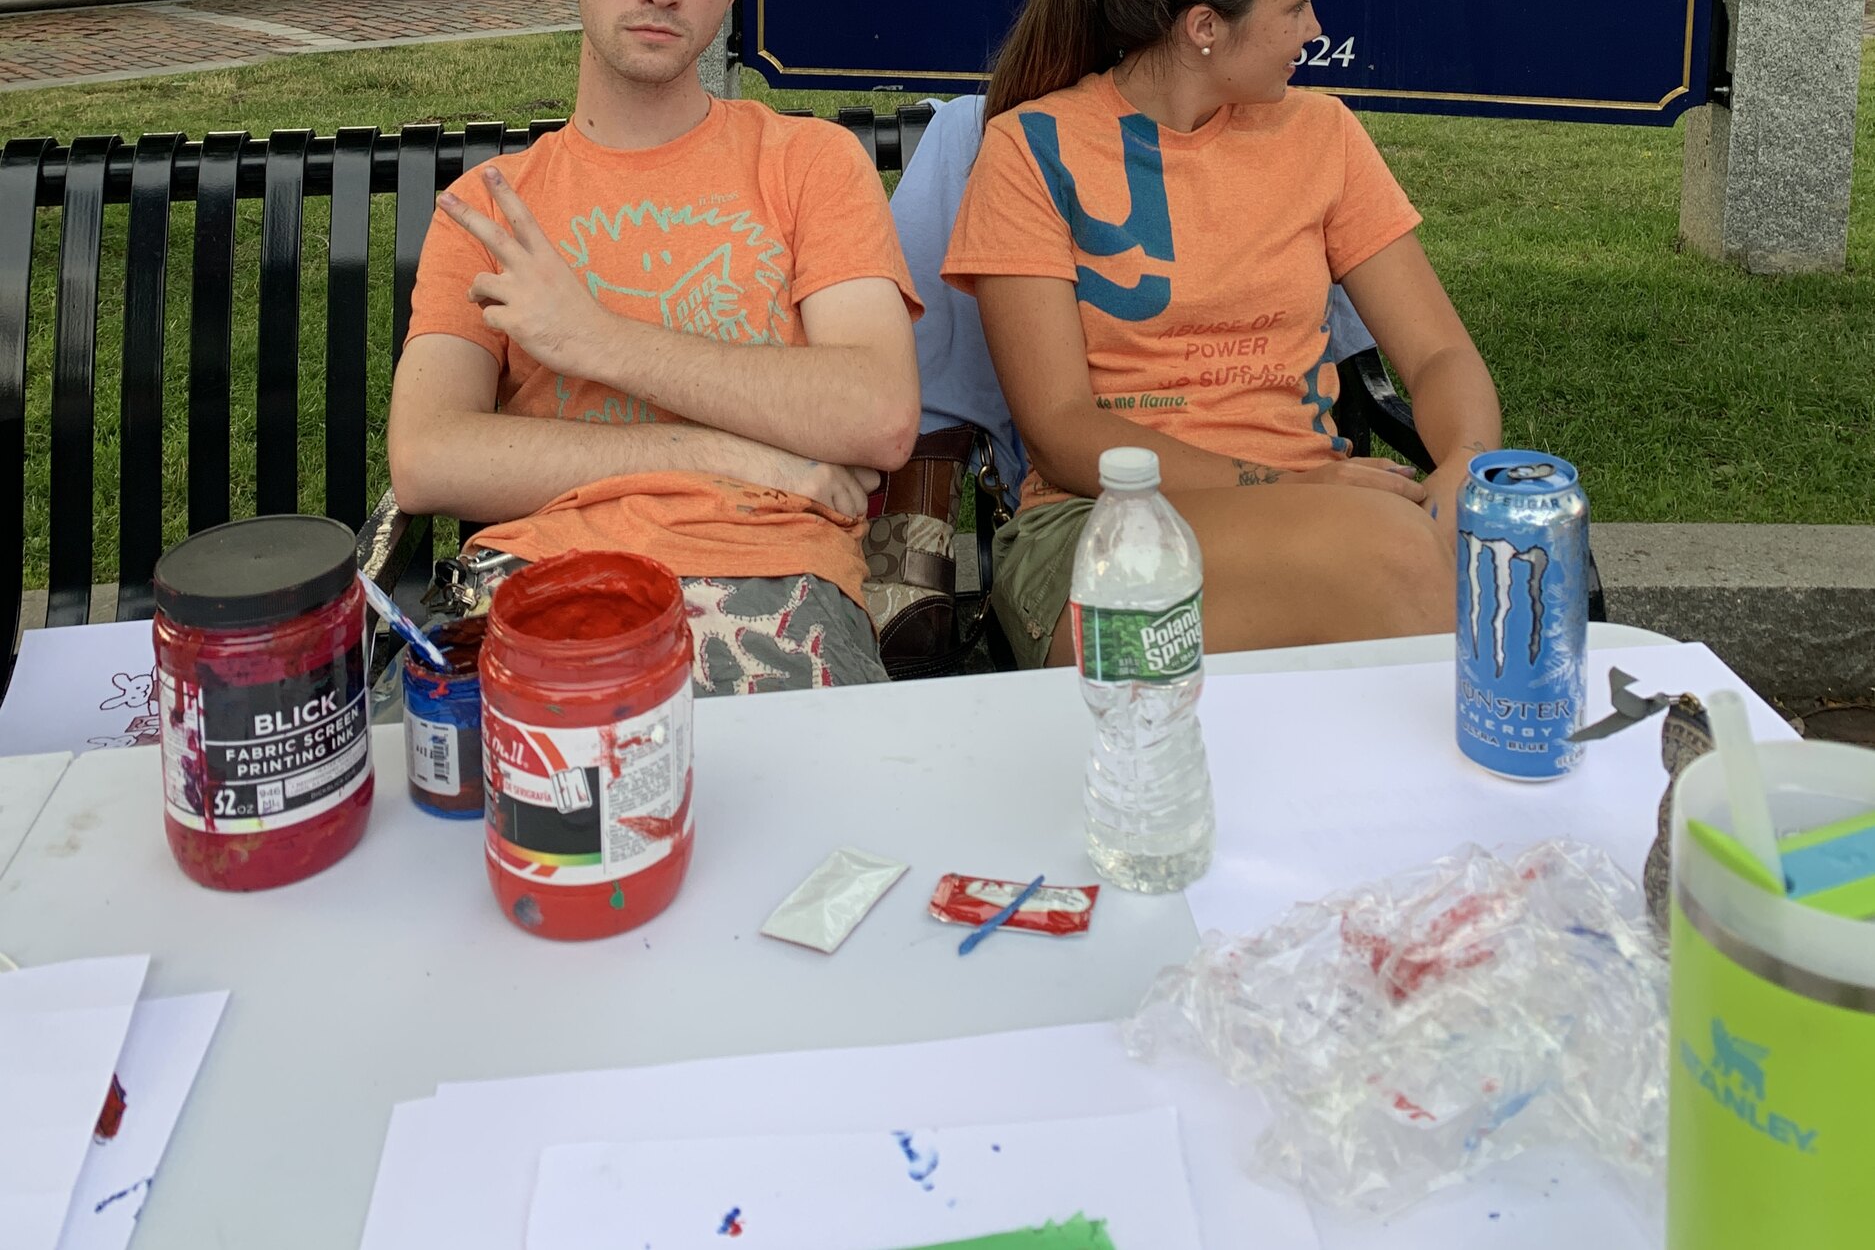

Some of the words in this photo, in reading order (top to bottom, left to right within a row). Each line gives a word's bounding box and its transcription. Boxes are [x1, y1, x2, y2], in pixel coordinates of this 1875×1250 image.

[1157, 319, 1242, 340] ABUSE
[1250, 311, 1286, 331] OF
[1184, 336, 1269, 361] POWER
[1114, 395, 1136, 410] me
[1503, 496, 1561, 509] SUGAR
[1140, 600, 1201, 650] Poland
[254, 690, 338, 736] BLICK
[1460, 680, 1571, 720] ONSTER
[225, 739, 297, 762] FABRIC
[304, 705, 359, 747] SCREEN
[1460, 703, 1553, 737] ENERGY
[237, 745, 326, 777] PRINTING
[331, 726, 355, 750] INK
[1506, 740, 1549, 753] BLUE
